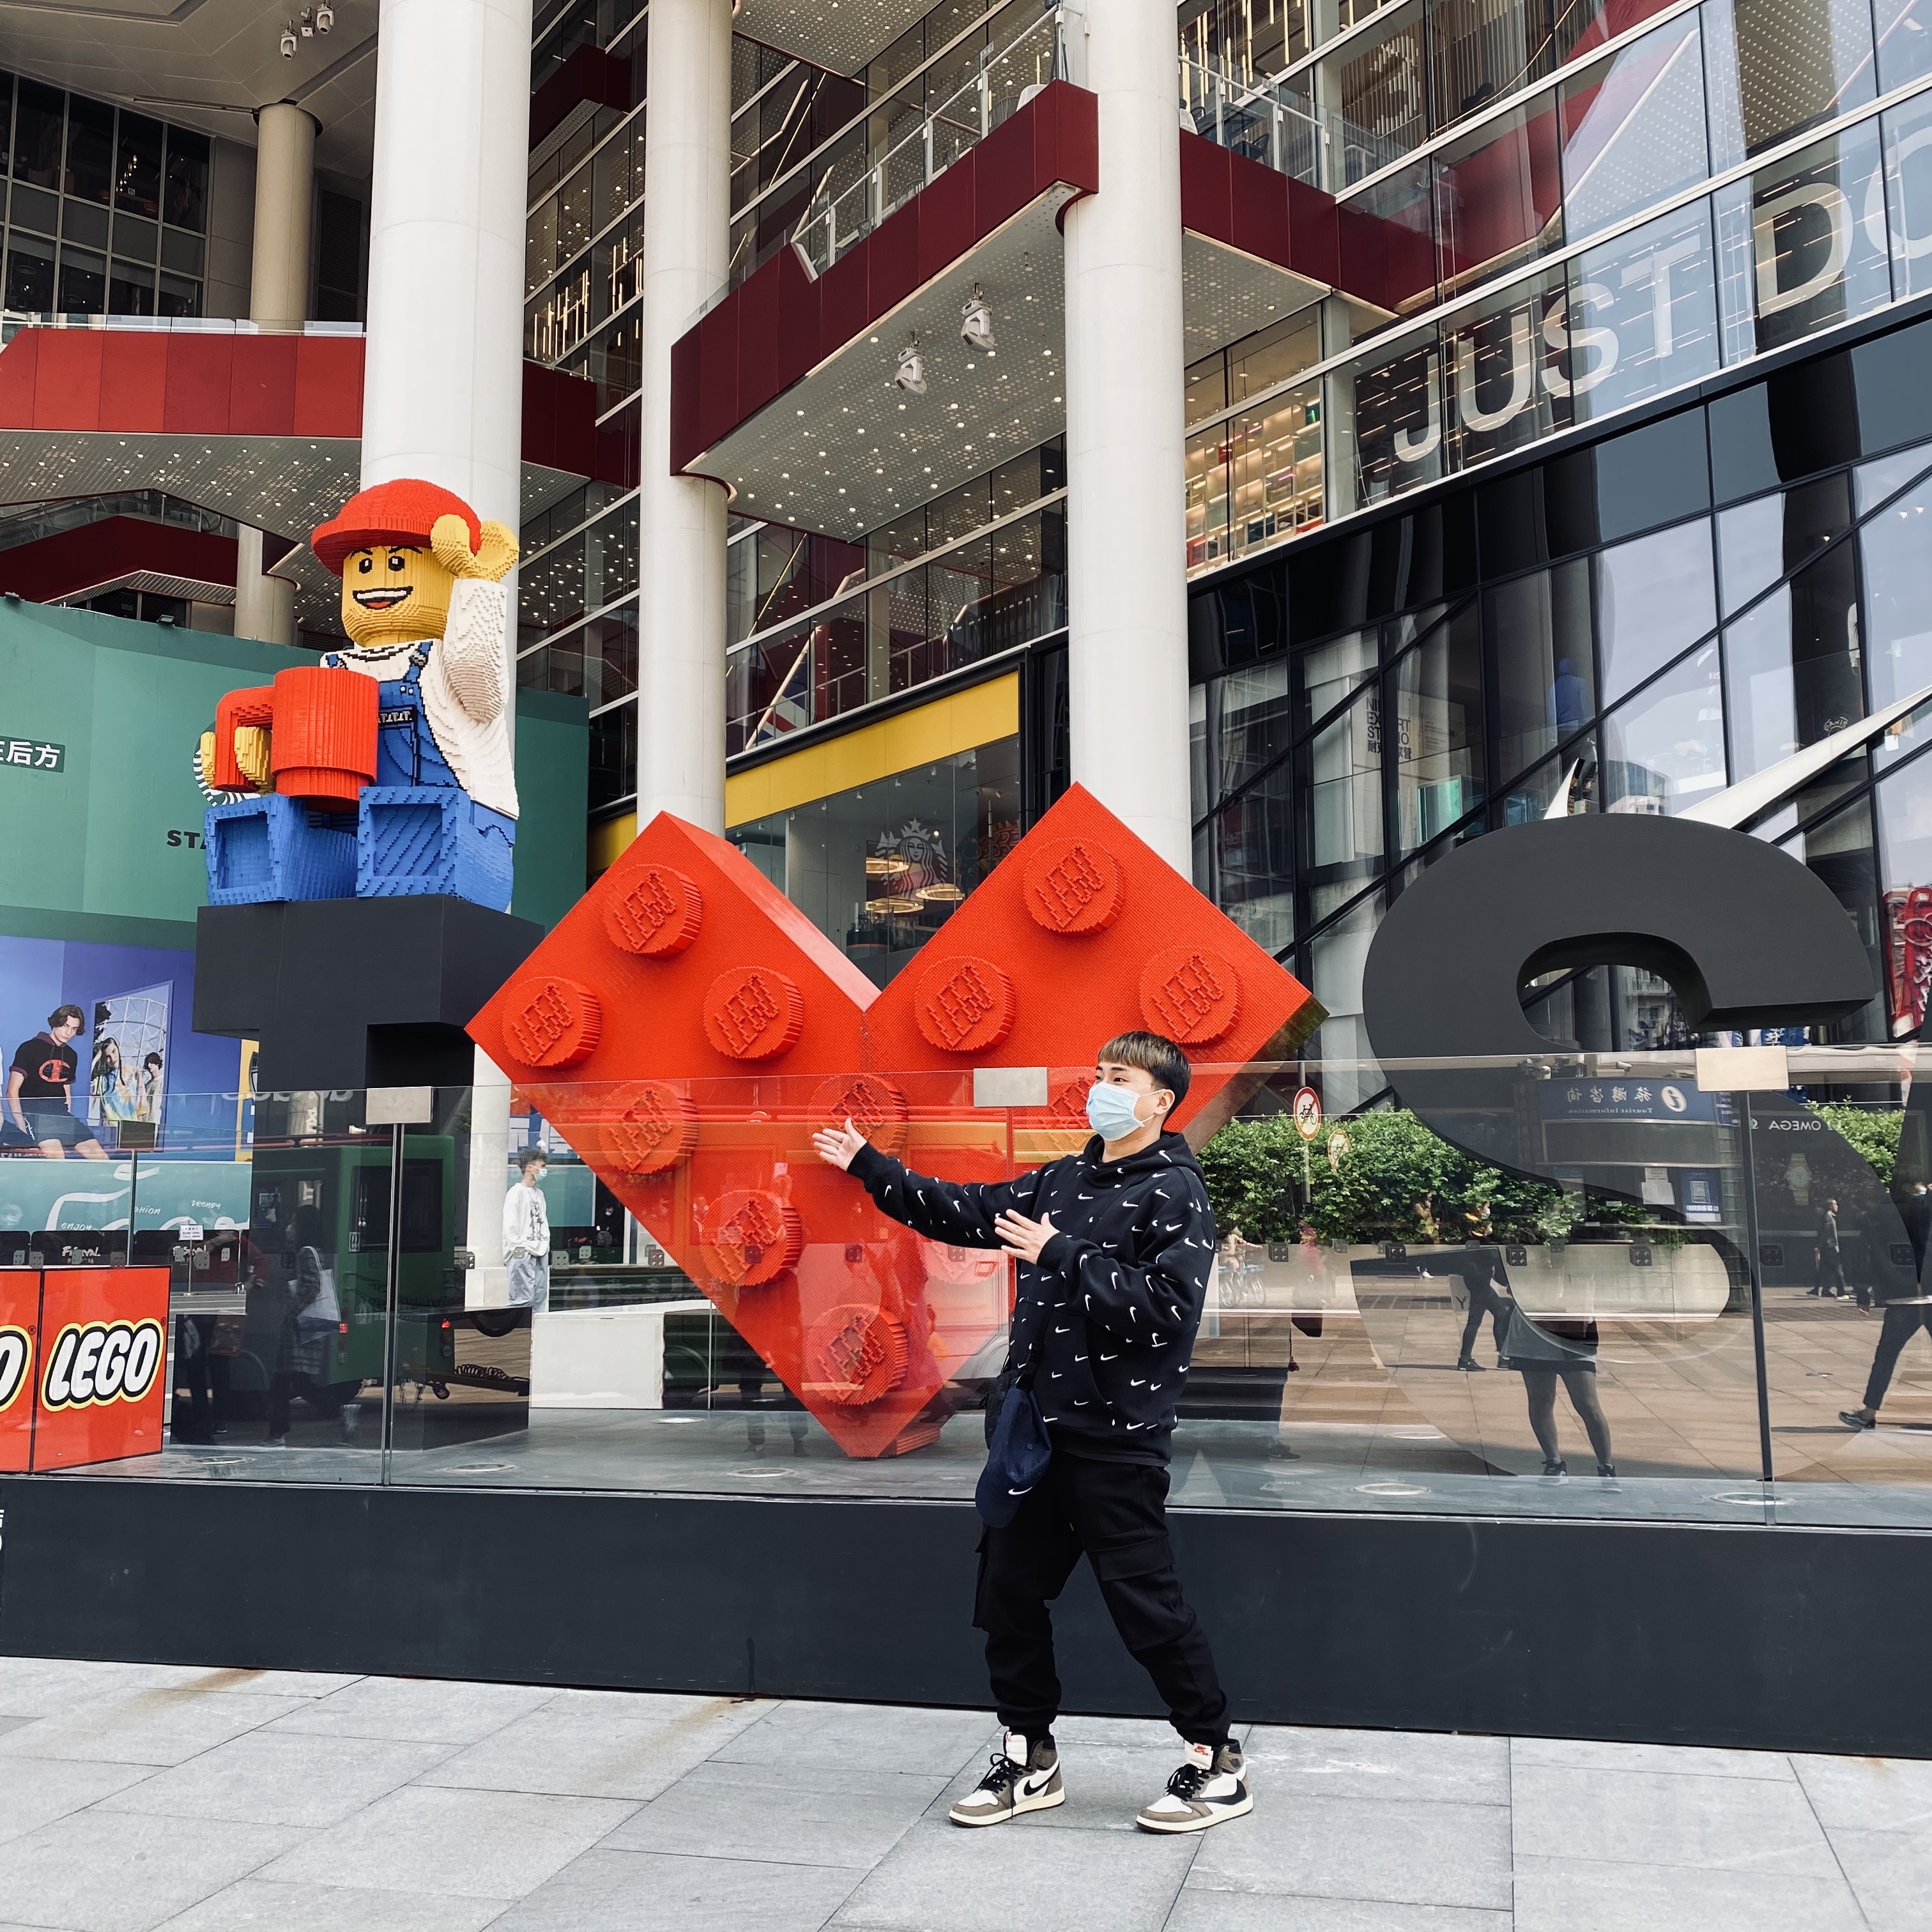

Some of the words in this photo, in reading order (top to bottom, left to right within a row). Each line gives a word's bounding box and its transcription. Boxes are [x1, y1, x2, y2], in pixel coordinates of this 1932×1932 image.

[1394, 236, 1701, 462] JUST
[1367, 711, 1411, 732] EXRT
[166, 830, 206, 849] ST
[45, 1323, 160, 1407] LEGO
